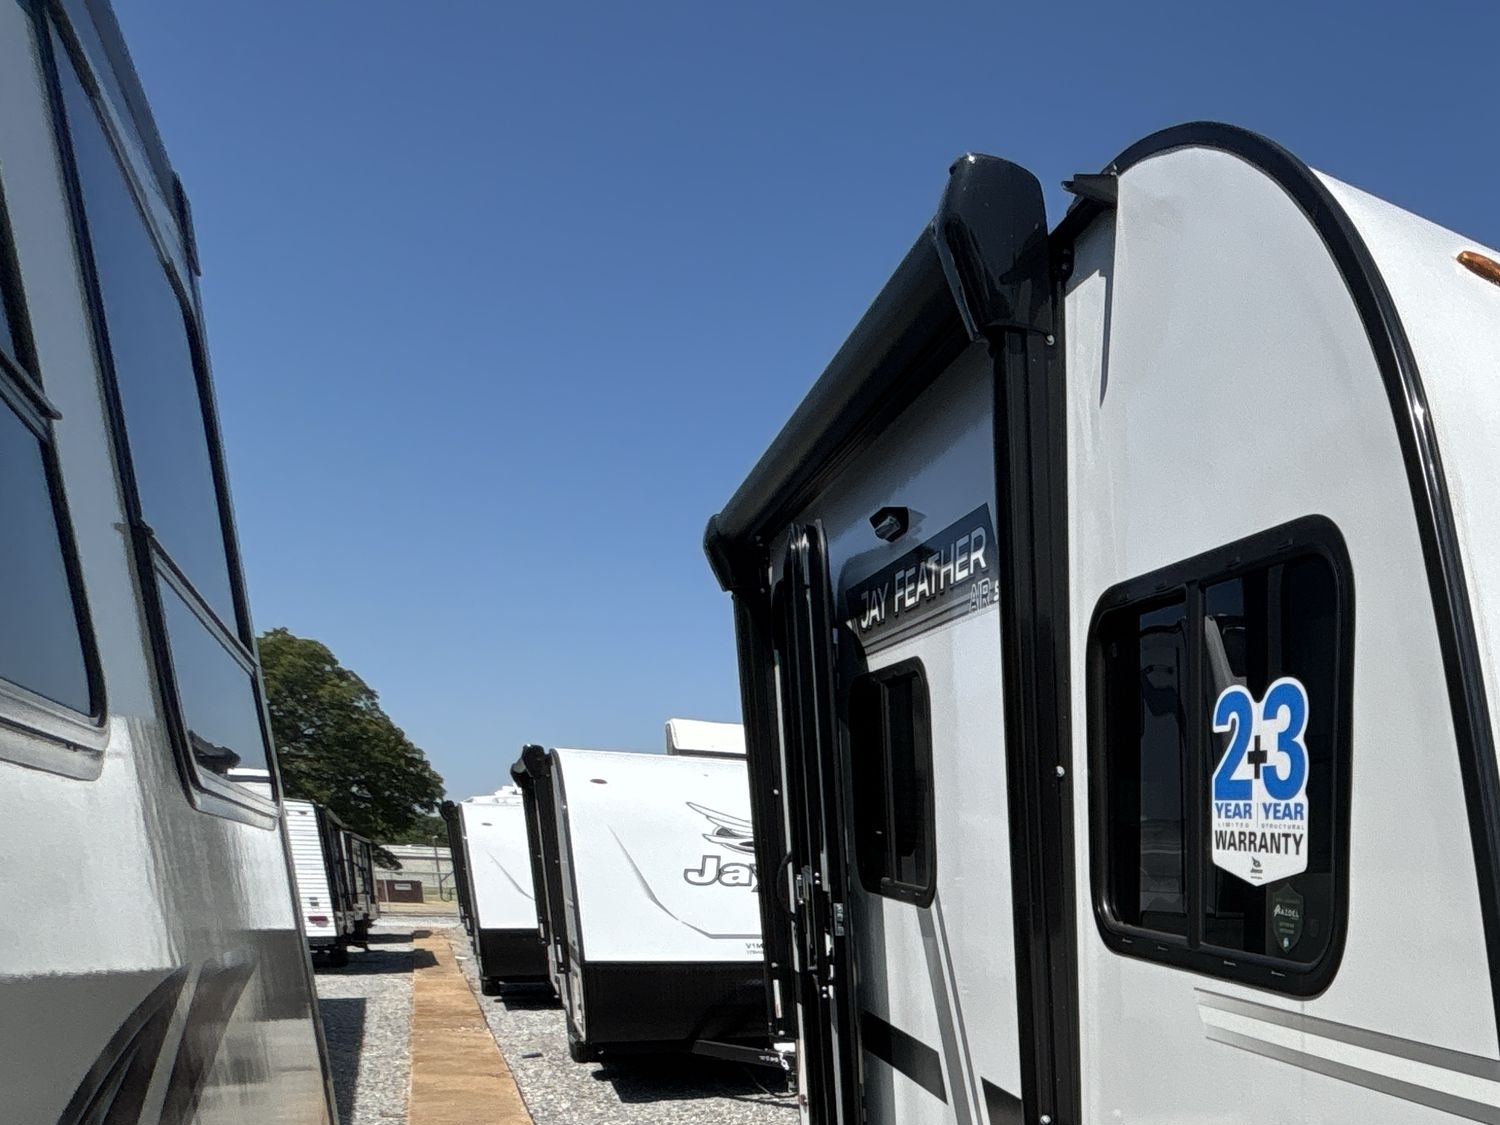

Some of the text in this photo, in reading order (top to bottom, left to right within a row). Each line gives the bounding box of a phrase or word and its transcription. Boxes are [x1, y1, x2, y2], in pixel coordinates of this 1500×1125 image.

[860, 526, 987, 629] JAY FEATHER
[1215, 802, 1304, 821] YEAR YEAR
[1261, 823, 1305, 831] STRUCTURAL
[1215, 830, 1304, 856] WARRANTY
